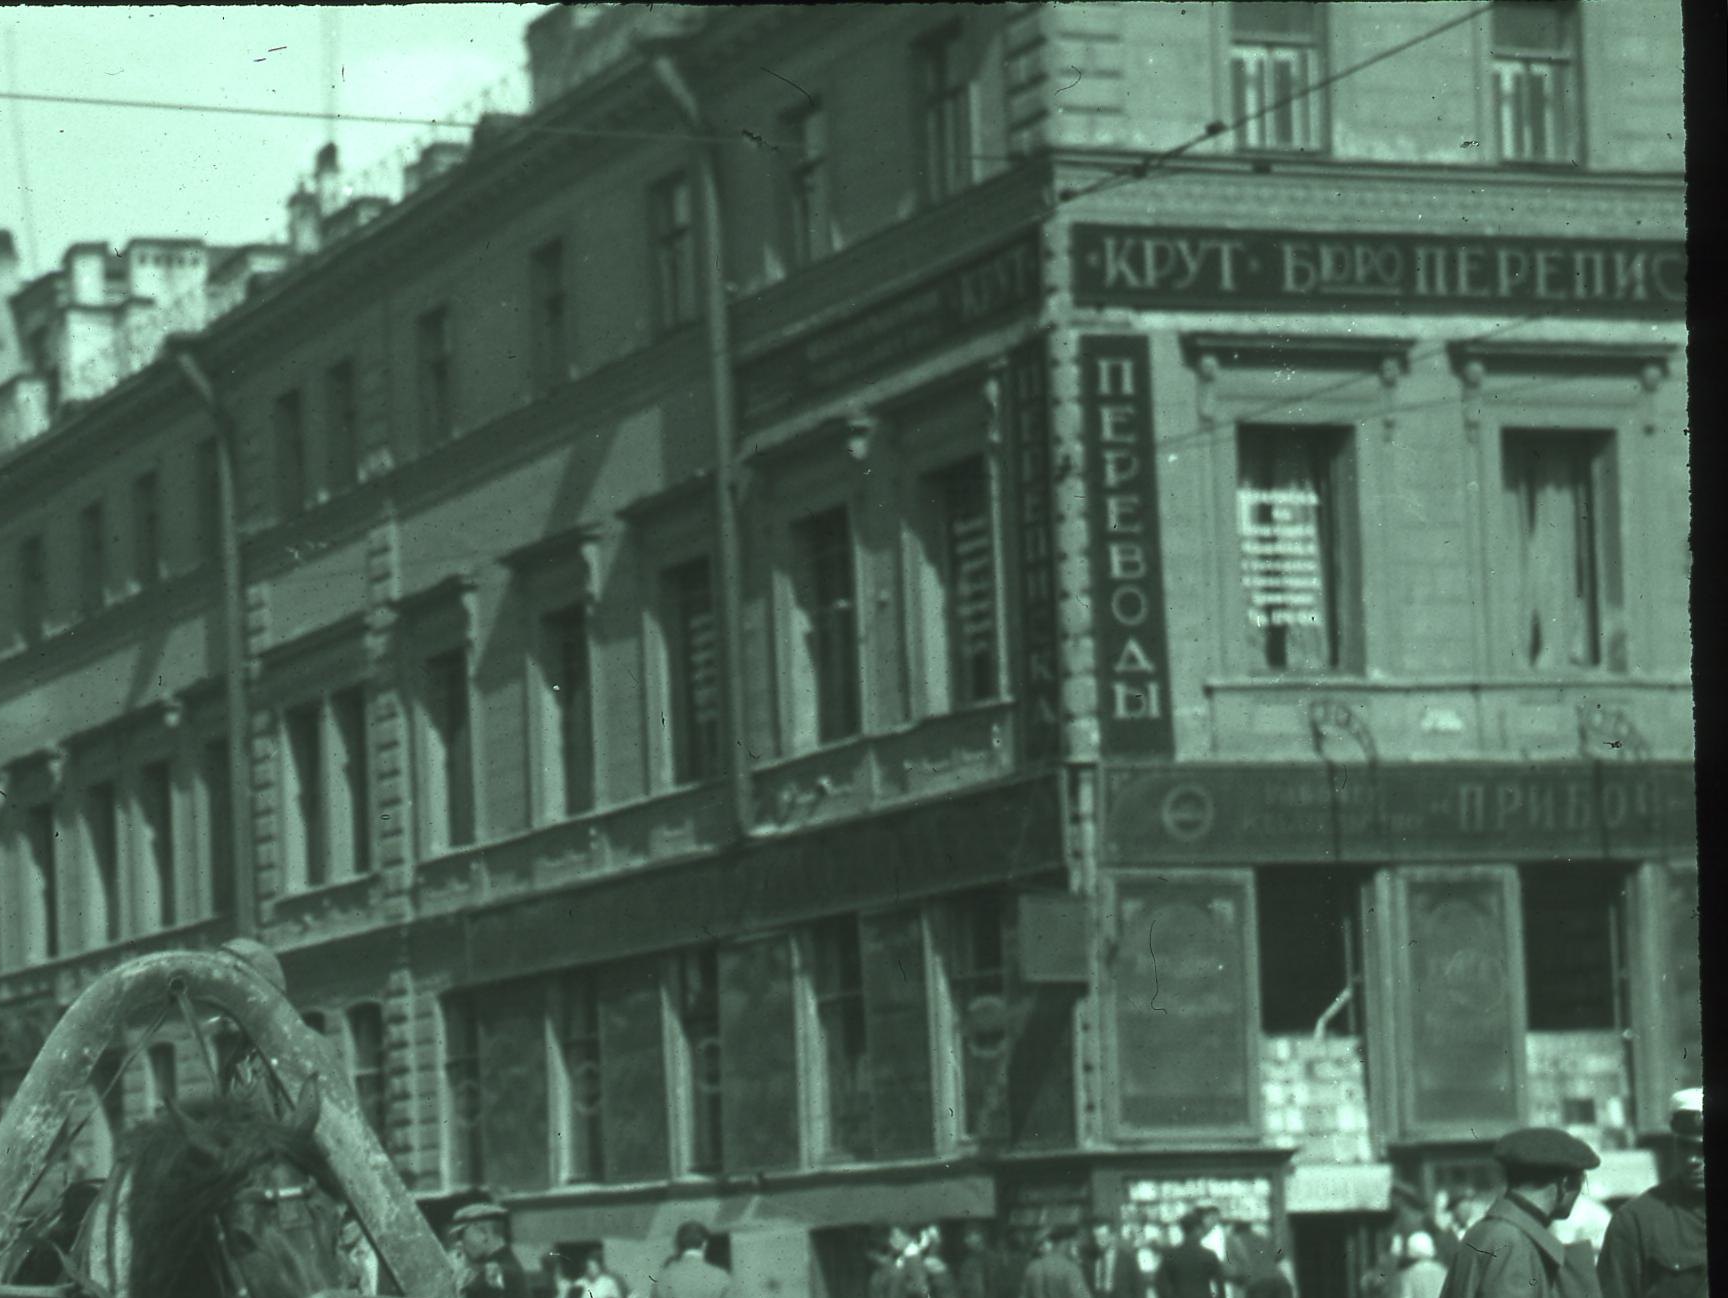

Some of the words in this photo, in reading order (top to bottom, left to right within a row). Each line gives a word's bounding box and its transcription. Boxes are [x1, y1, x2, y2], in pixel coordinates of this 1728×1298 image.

[1102, 236, 1246, 294] КРУТ
[1281, 243, 1403, 296] БЮРО
[1413, 244, 1687, 302] ПЕРЕПИС
[1095, 356, 1161, 721] ПЕРЕВОДЫ
